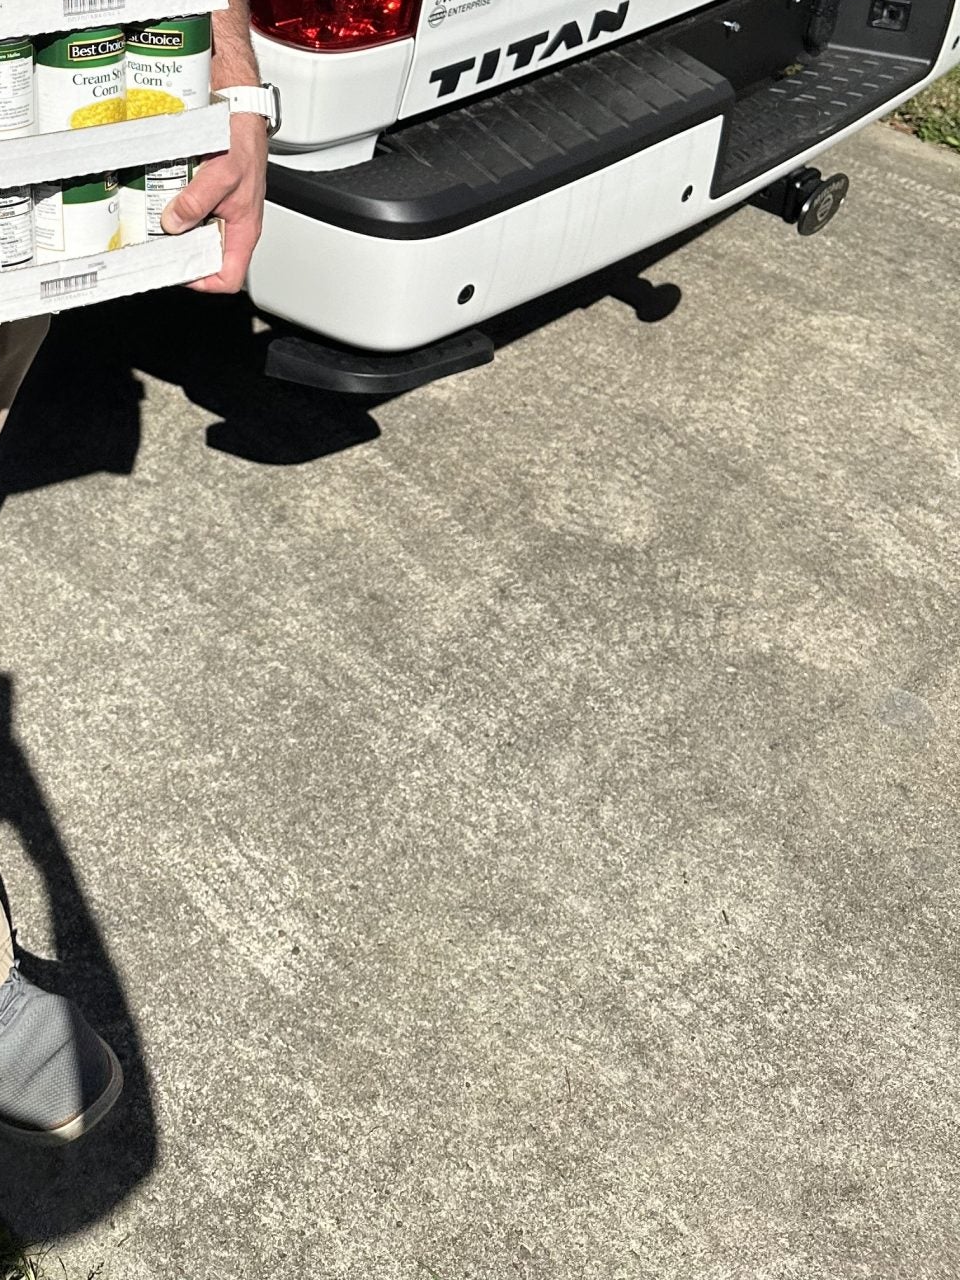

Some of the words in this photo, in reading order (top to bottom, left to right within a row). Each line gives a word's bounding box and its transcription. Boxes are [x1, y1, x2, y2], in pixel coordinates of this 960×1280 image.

[71, 44, 97, 58] Best
[429, 0, 630, 99] TITAN
[127, 60, 152, 73] ream
[154, 60, 183, 78] Style
[72, 73, 111, 86] Cream
[133, 72, 163, 87] Corn
[92, 84, 118, 98] Corn
